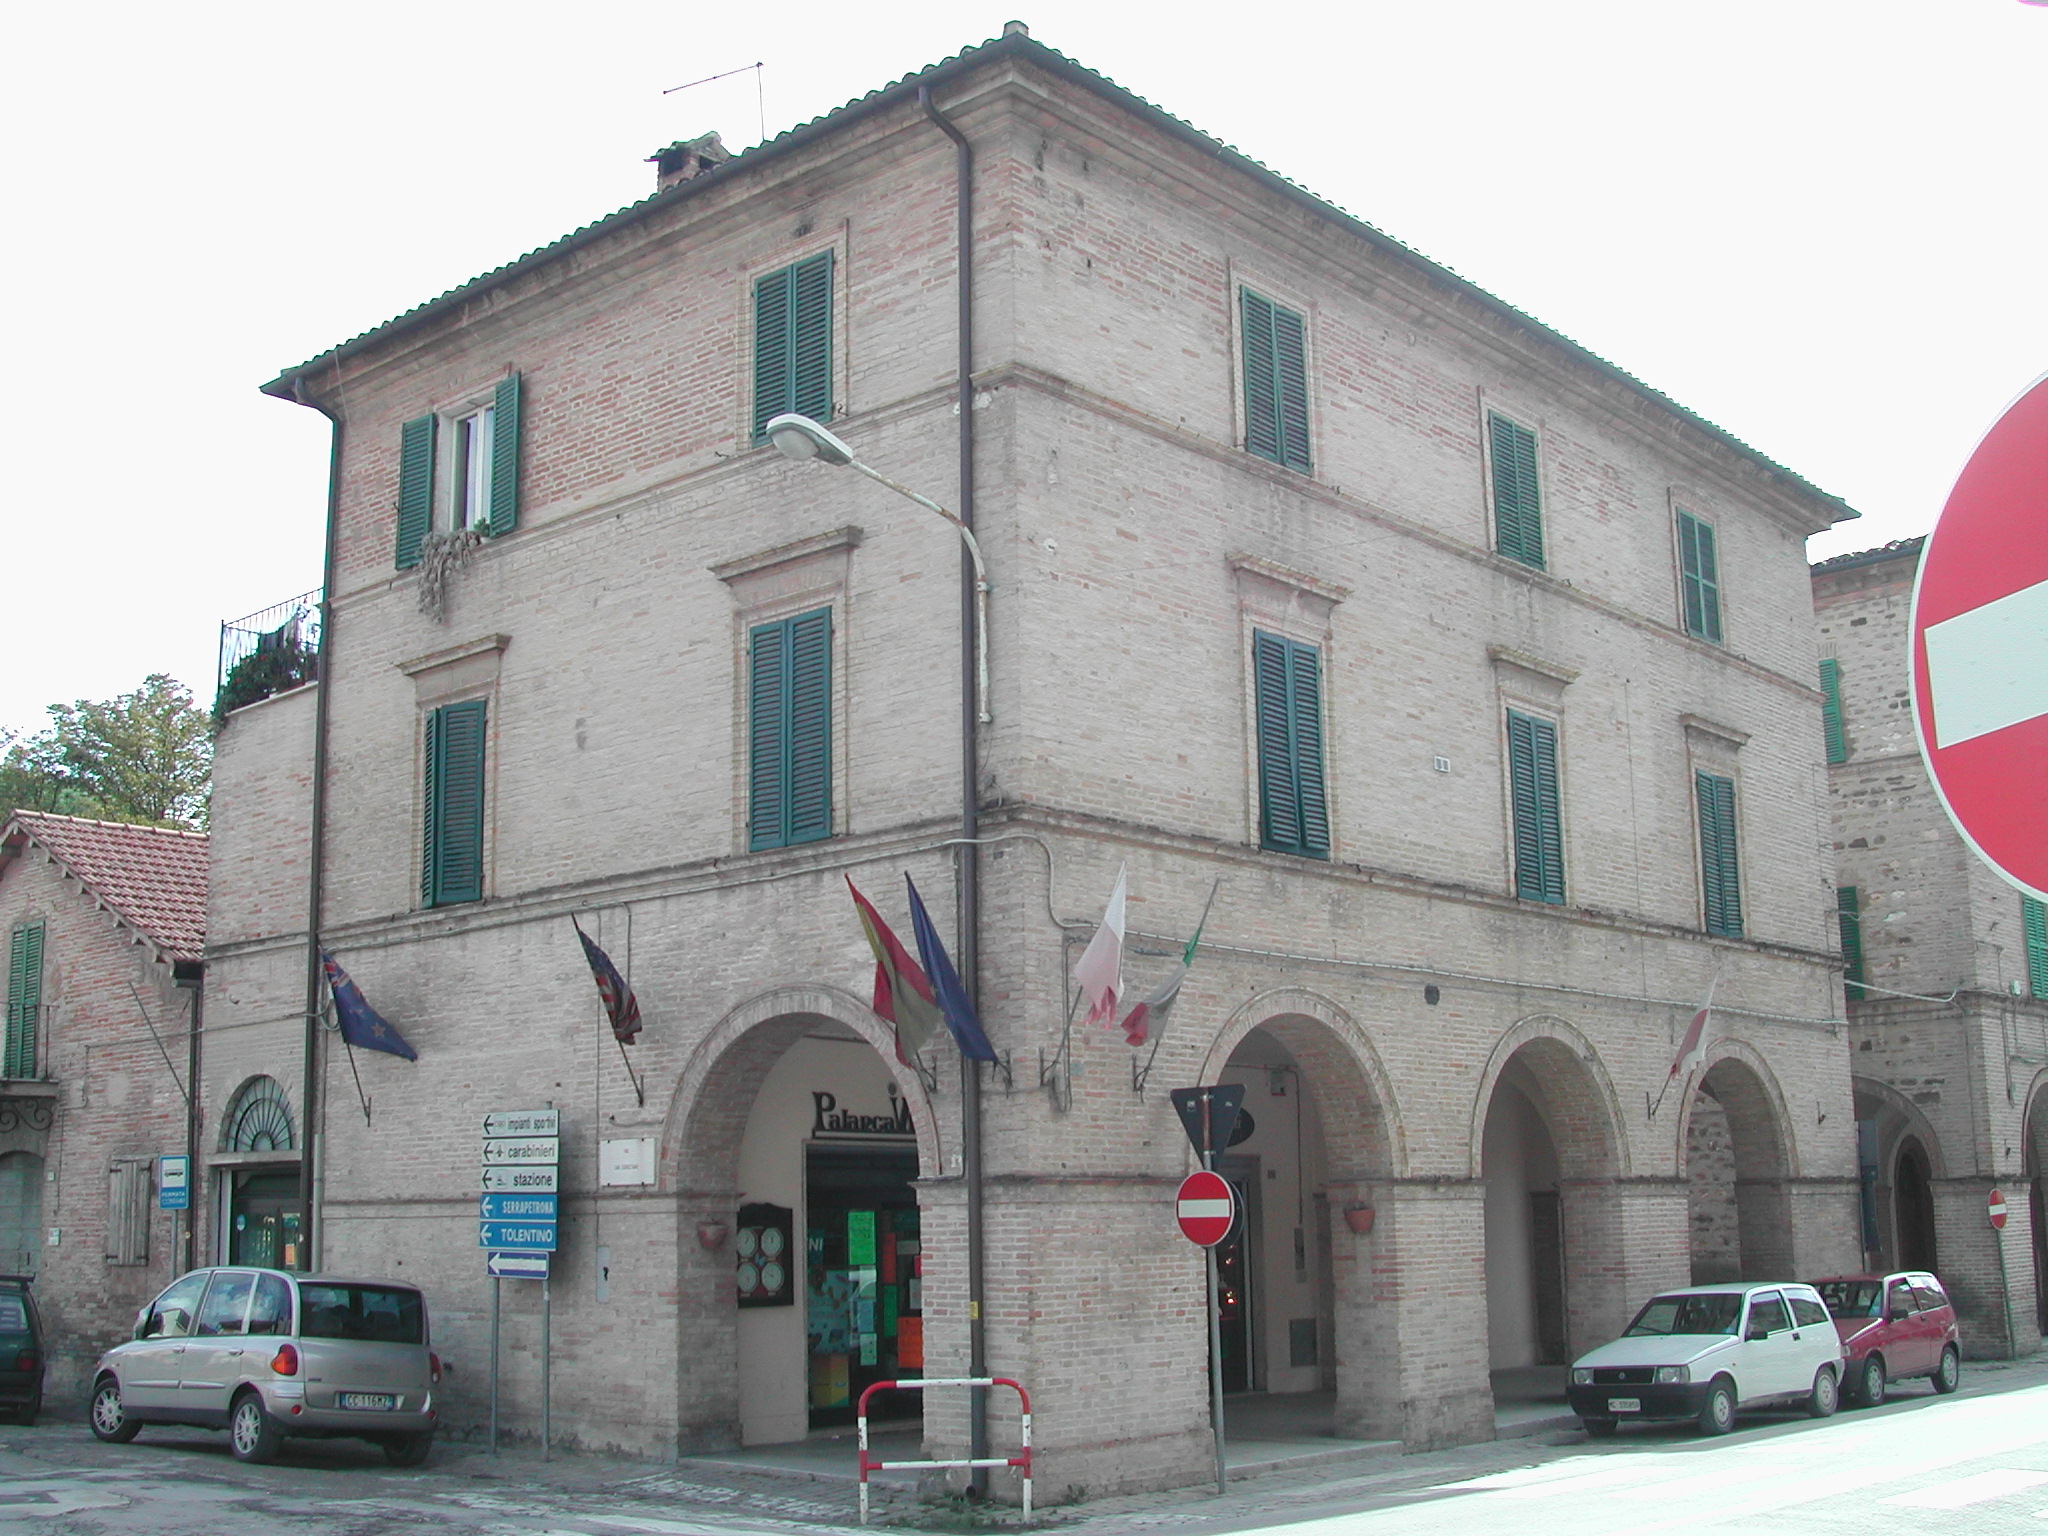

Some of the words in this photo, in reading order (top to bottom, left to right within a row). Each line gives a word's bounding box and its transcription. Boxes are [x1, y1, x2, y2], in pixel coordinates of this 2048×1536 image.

[507, 1116, 531, 1133] impianti
[533, 1115, 556, 1132] sportivi
[507, 1143, 555, 1159] carabinieri
[513, 1172, 553, 1187] stazione
[502, 1200, 554, 1214] SERRAPETRONA
[501, 1228, 553, 1243] TOLENTINO
